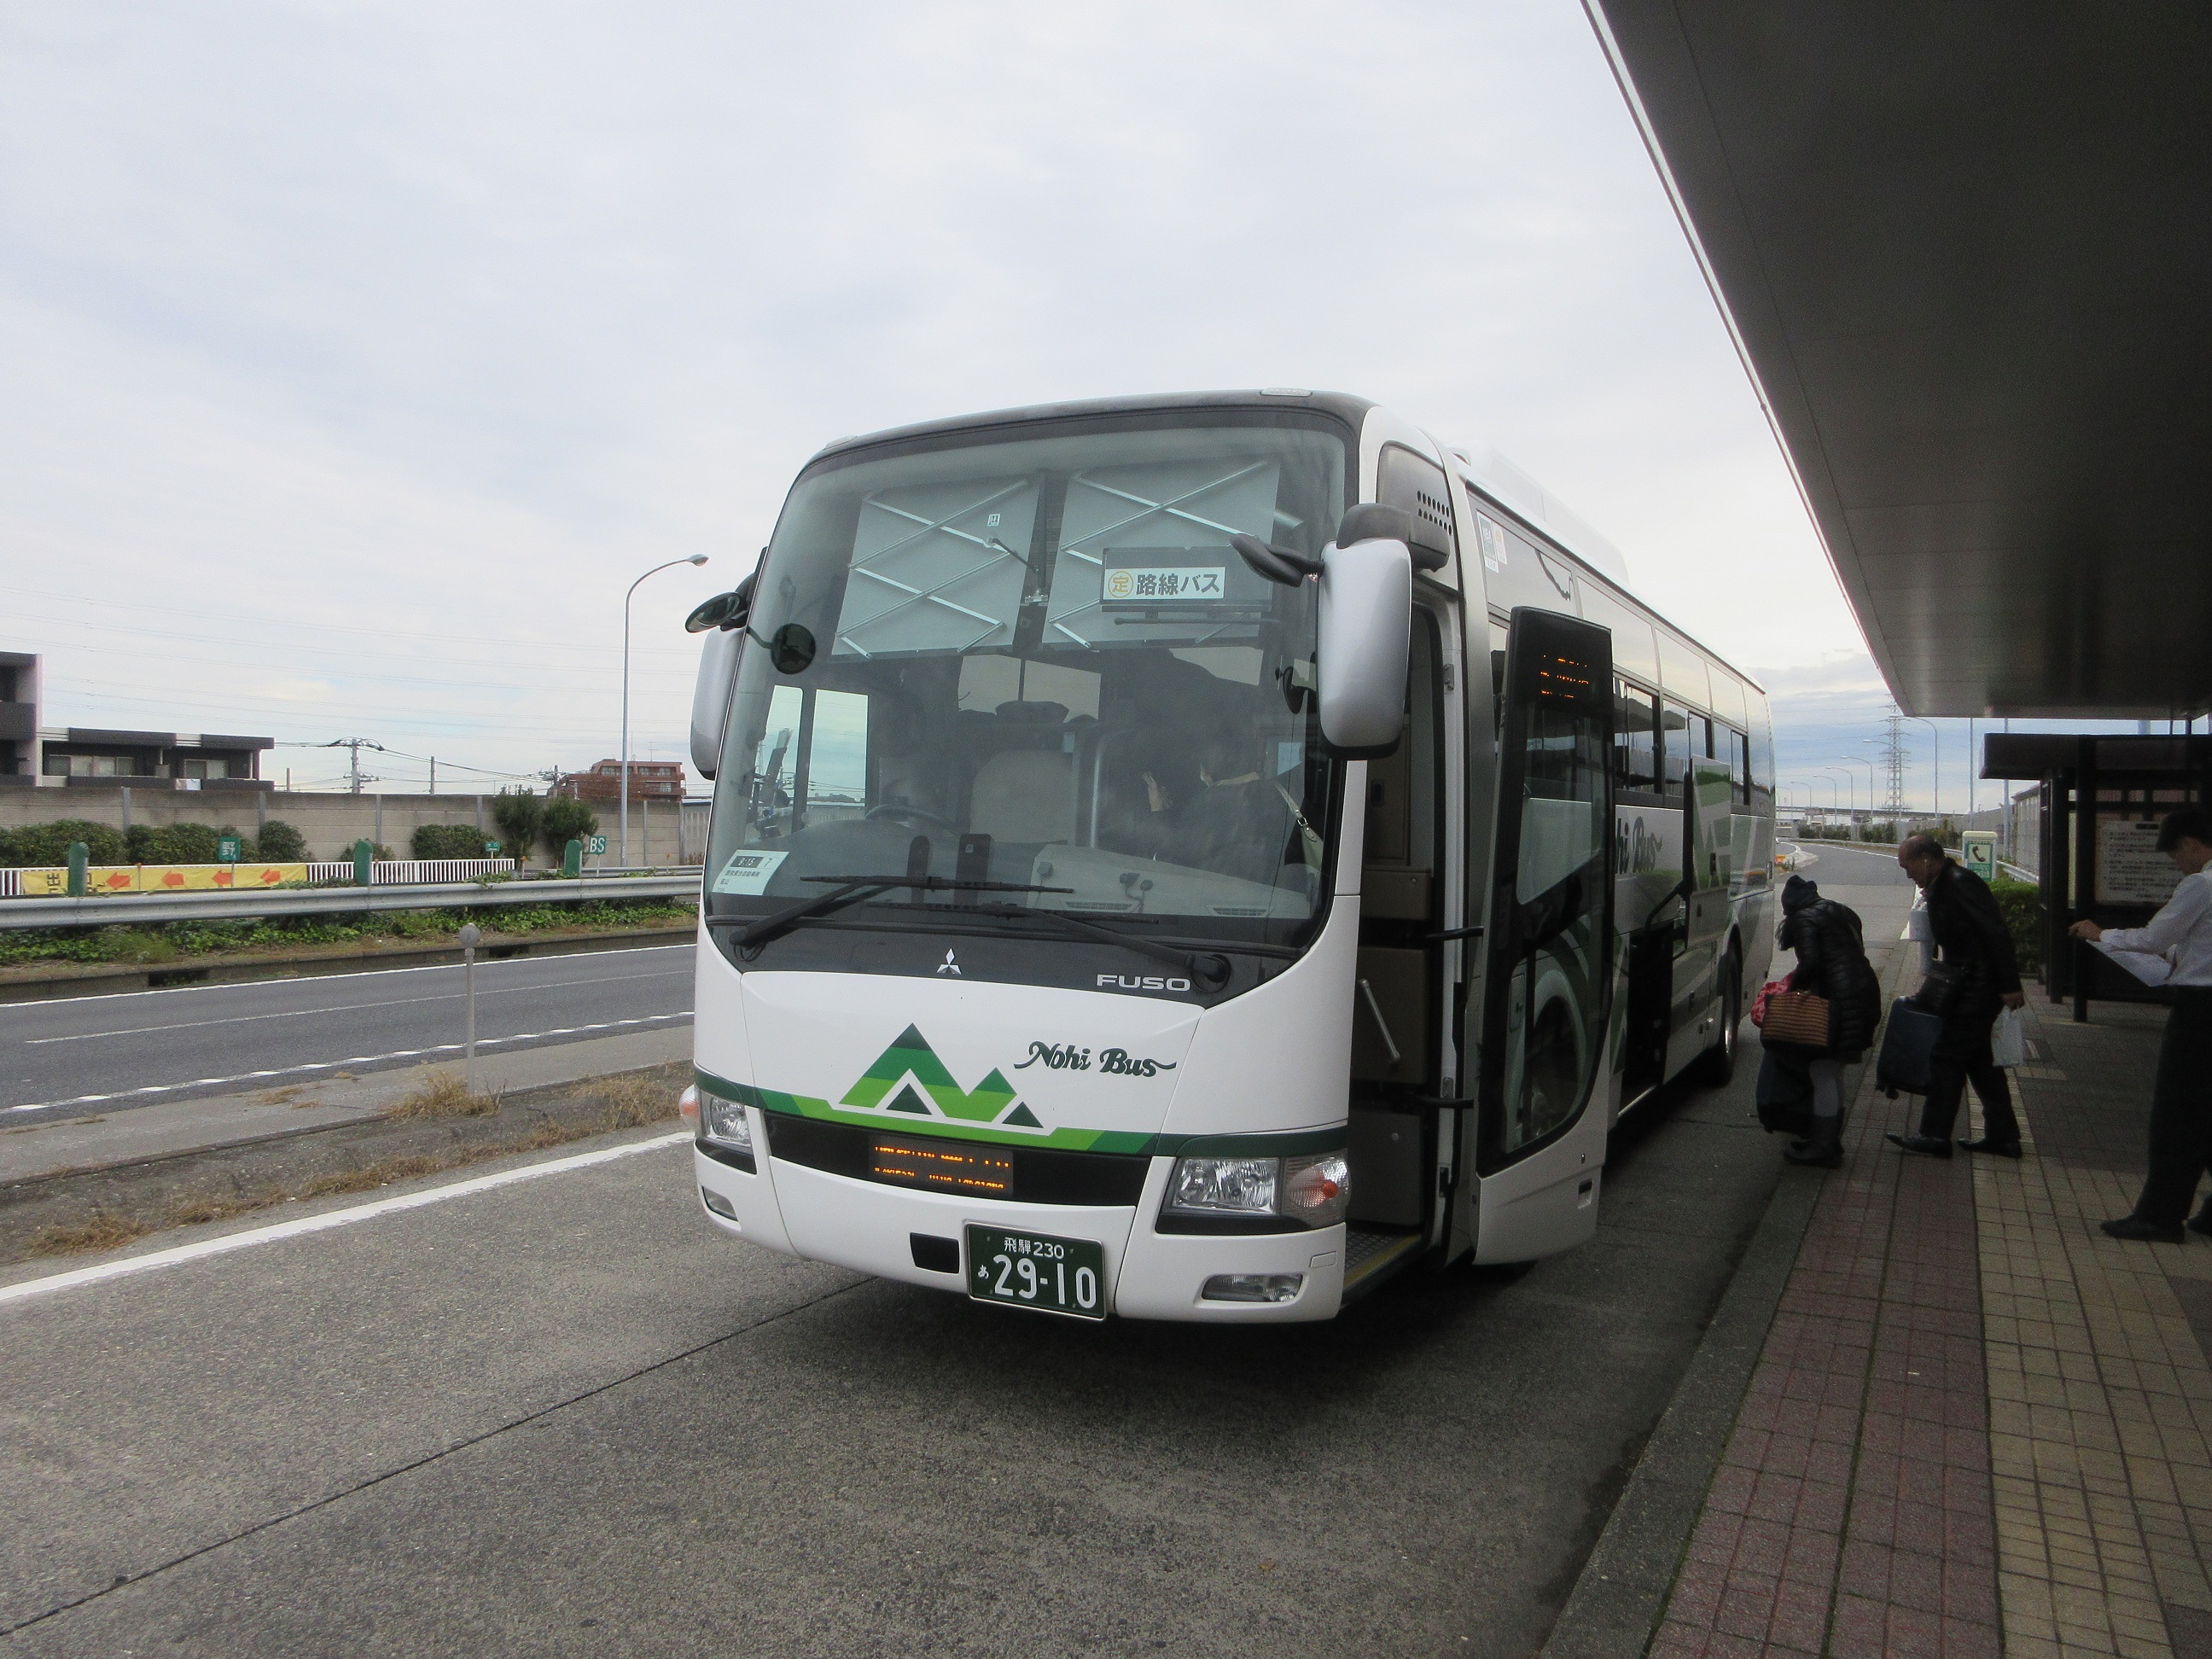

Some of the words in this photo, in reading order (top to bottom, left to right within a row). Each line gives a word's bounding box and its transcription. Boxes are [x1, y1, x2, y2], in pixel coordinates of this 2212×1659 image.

[1136, 573, 1220, 596] 路線バス
[590, 837, 605, 853] BS
[1632, 816, 1663, 873] Bus
[1096, 974, 1190, 992] FUSO
[1013, 1040, 1091, 1071] Nohi
[1099, 1047, 1178, 1078] Bus
[1033, 1242, 1065, 1260] 230
[977, 1264, 990, 1279] あ
[992, 1254, 1097, 1308] 29-10
